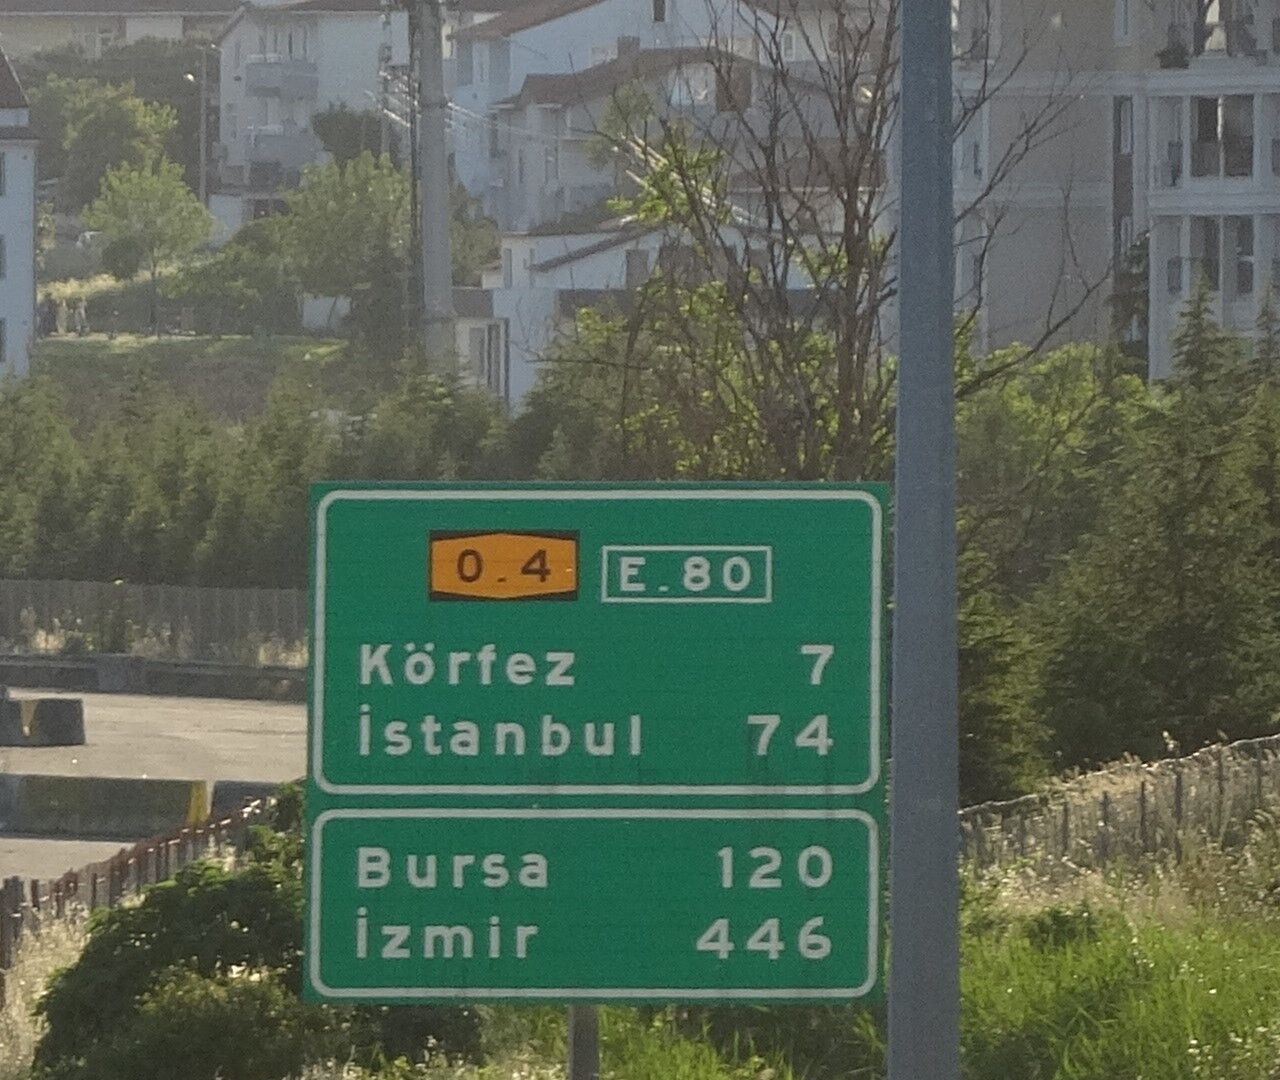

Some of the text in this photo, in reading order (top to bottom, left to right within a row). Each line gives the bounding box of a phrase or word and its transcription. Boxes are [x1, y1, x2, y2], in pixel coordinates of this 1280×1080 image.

[620, 556, 751, 592] E.80
[360, 643, 834, 686] Körfez 7
[360, 704, 833, 756] İstanbul 74
[358, 845, 832, 888] Bursa 120
[357, 907, 831, 960] İzmir 446
